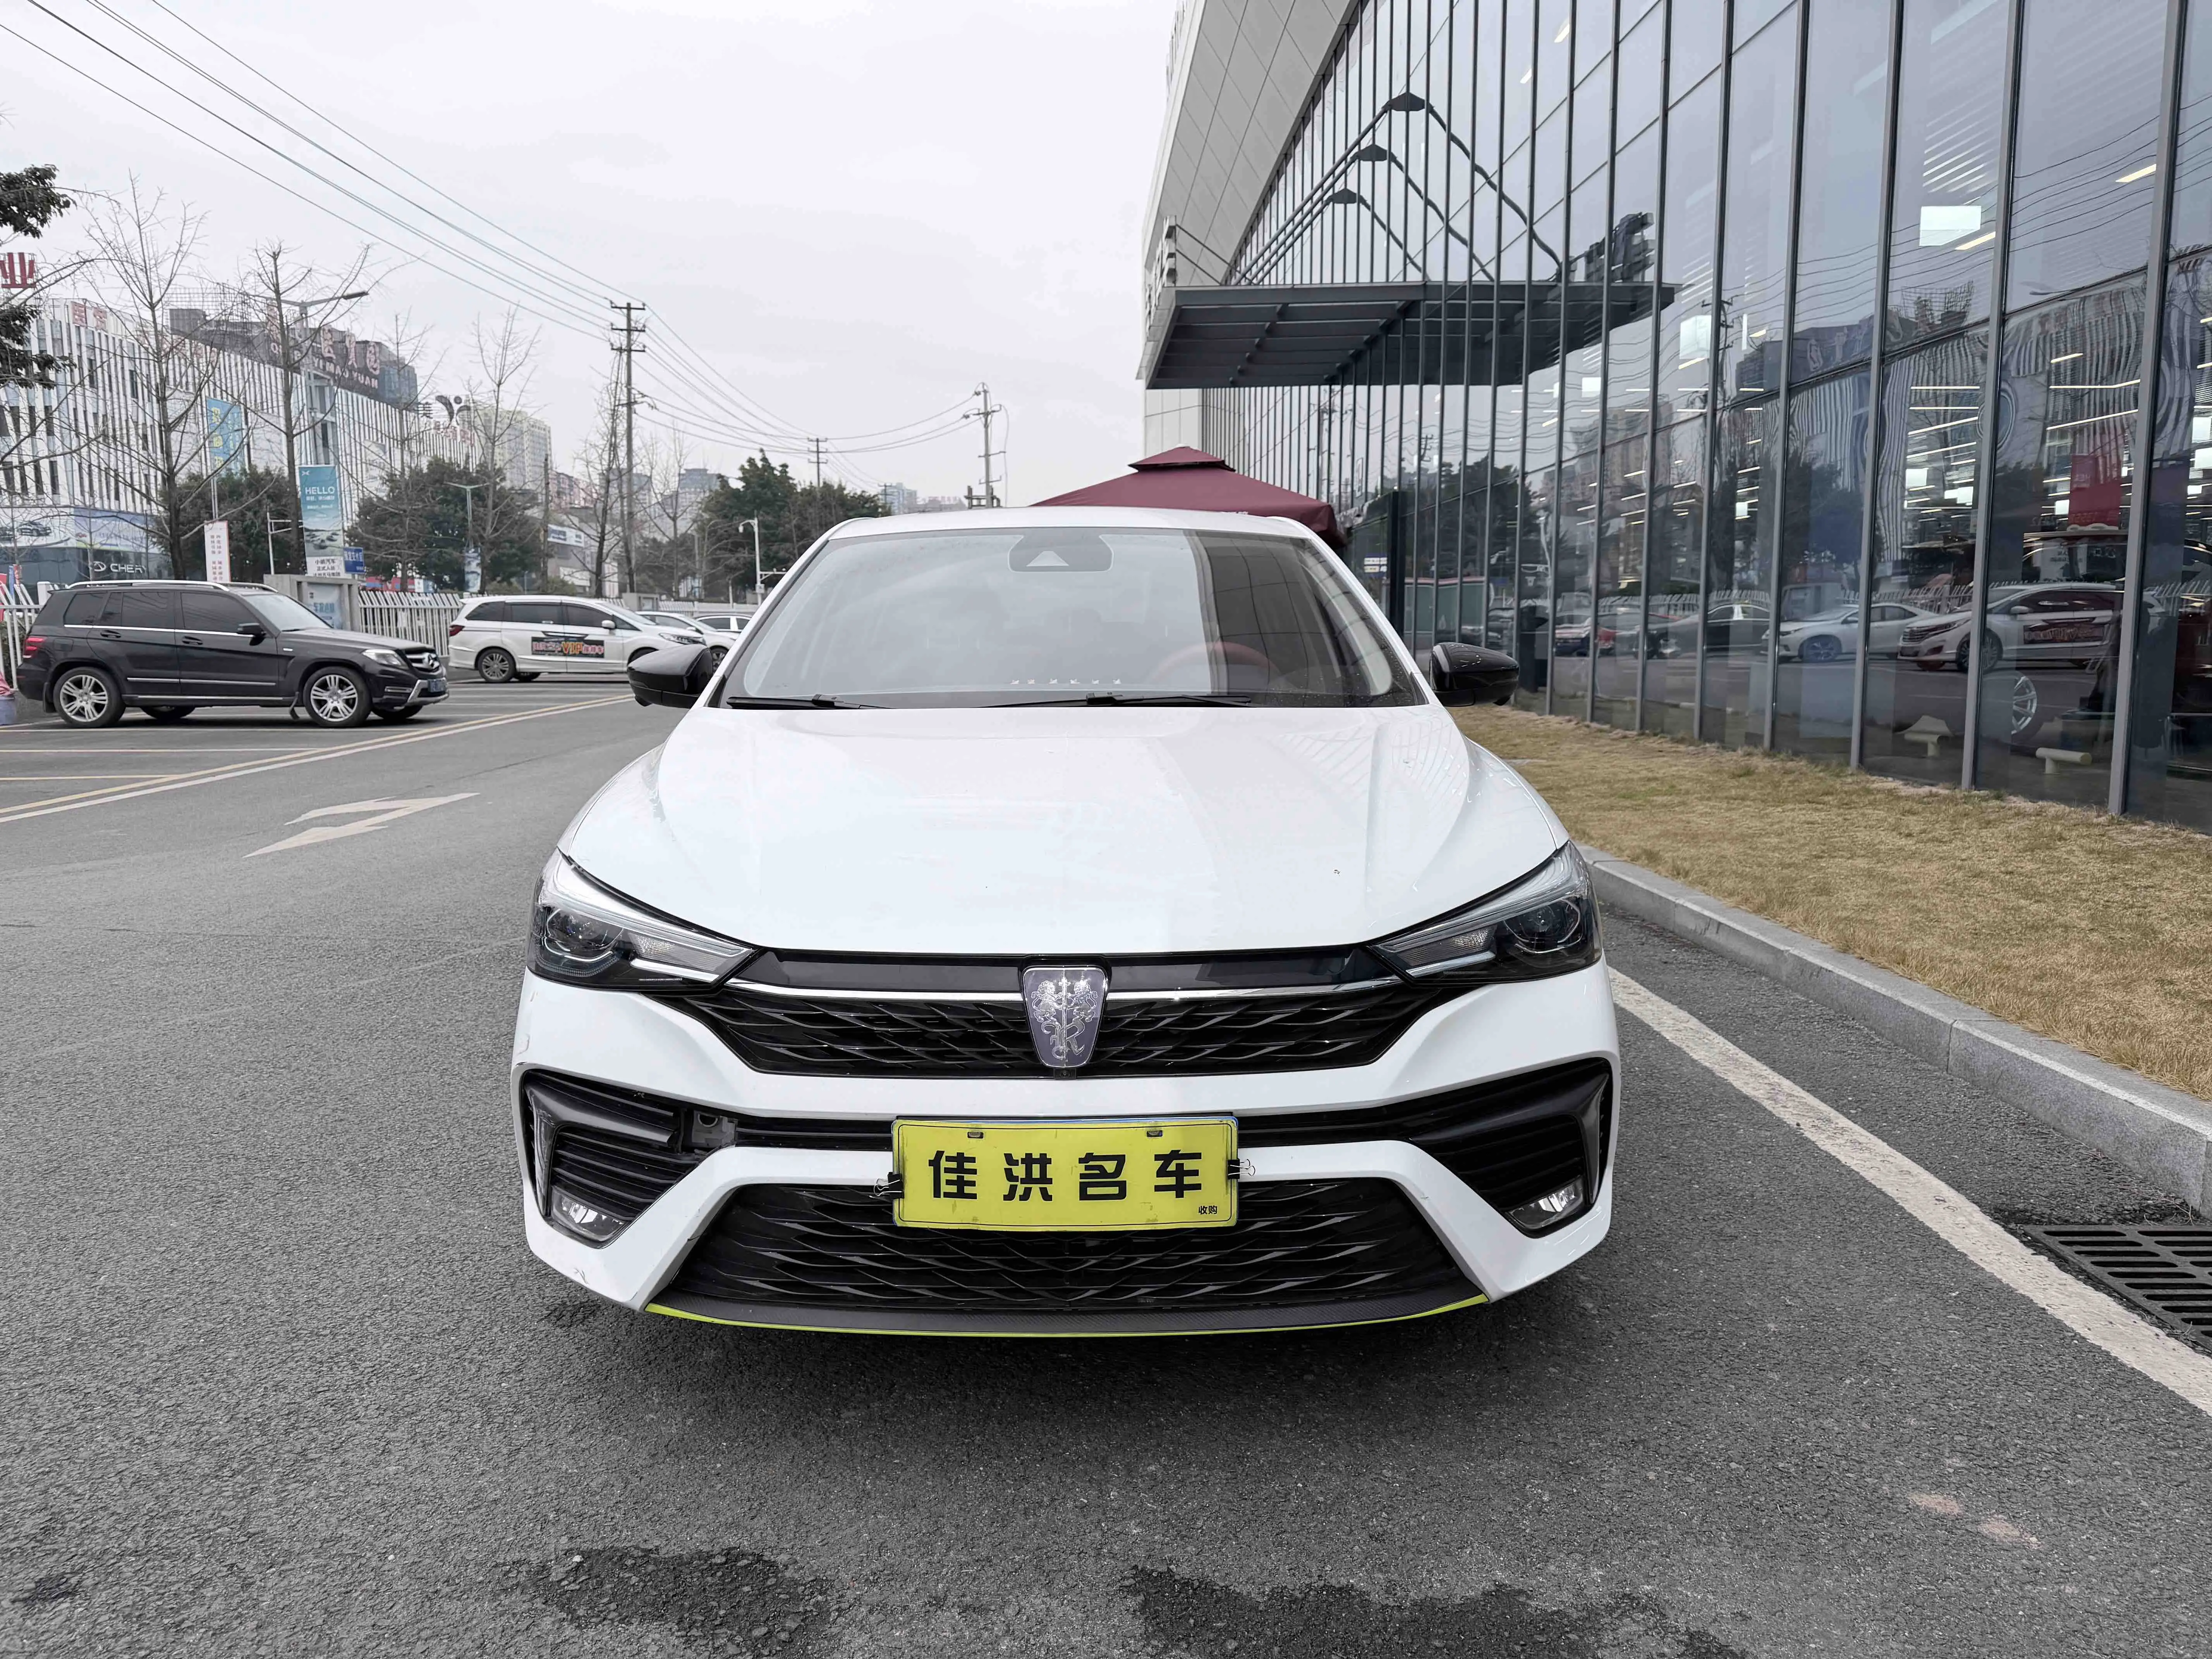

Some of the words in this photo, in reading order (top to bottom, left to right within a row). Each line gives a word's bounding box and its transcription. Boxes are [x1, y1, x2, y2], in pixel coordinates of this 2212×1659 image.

[352, 370, 378, 389] YUAN
[305, 486, 335, 495] HELLO
[110, 563, 146, 574] CHERY
[562, 641, 583, 654] VIP
[928, 1149, 1202, 1202] 佳洪名车
[1198, 1205, 1218, 1215] 收购
